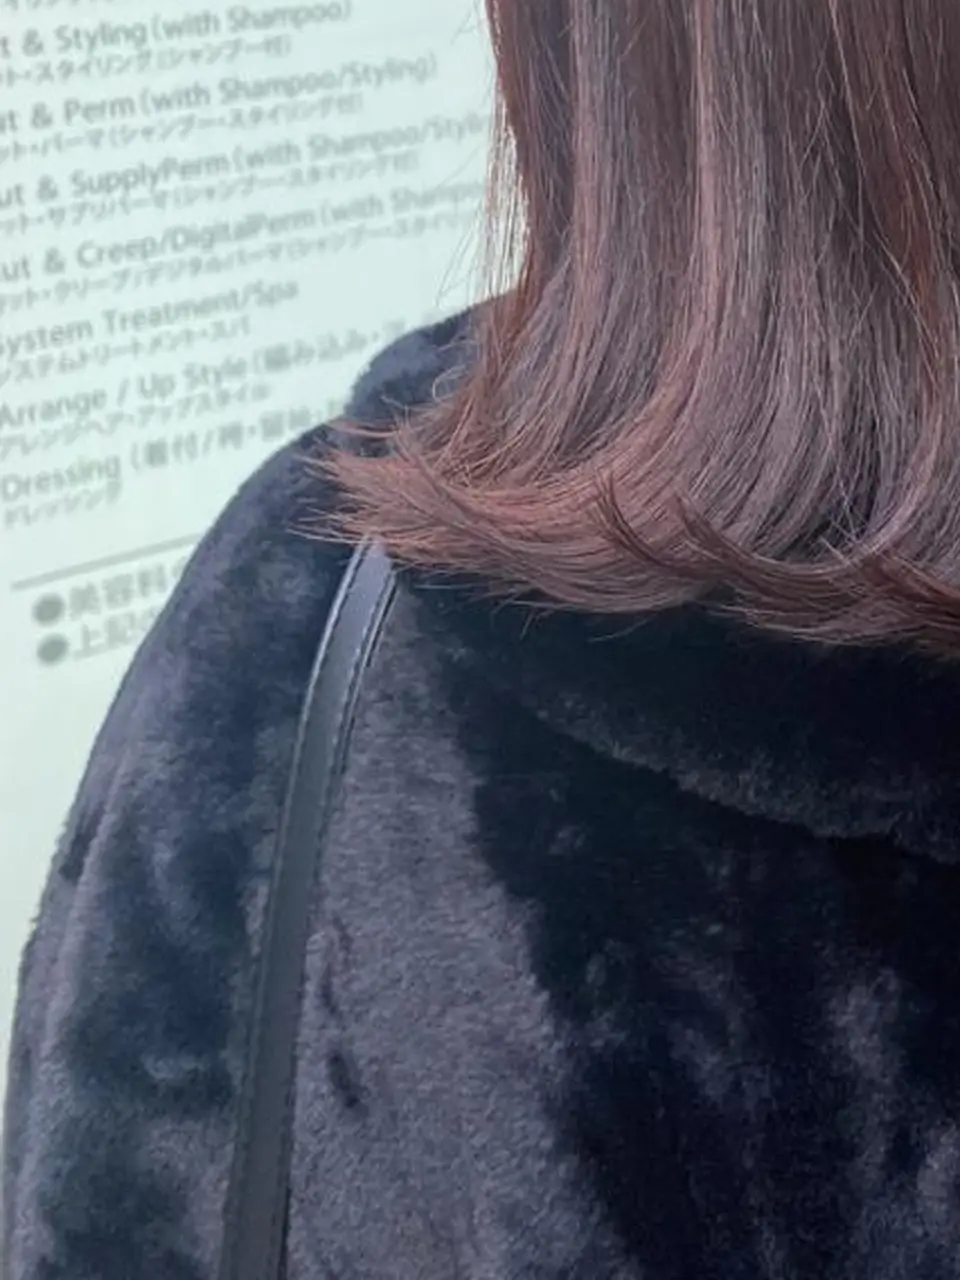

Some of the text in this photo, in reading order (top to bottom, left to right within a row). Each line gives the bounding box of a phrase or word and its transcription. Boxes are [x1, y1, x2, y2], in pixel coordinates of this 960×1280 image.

[22, 27, 45, 58] &
[53, 20, 148, 56] Styling
[30, 101, 53, 131] &
[63, 95, 136, 127] Perm
[36, 173, 59, 203] &
[43, 246, 66, 276] &
[0, 319, 94, 363] ystem
[0, 388, 108, 429] Arrange
[137, 371, 177, 404] Up
[181, 352, 249, 392] Style
[1, 452, 122, 503] Dressing
